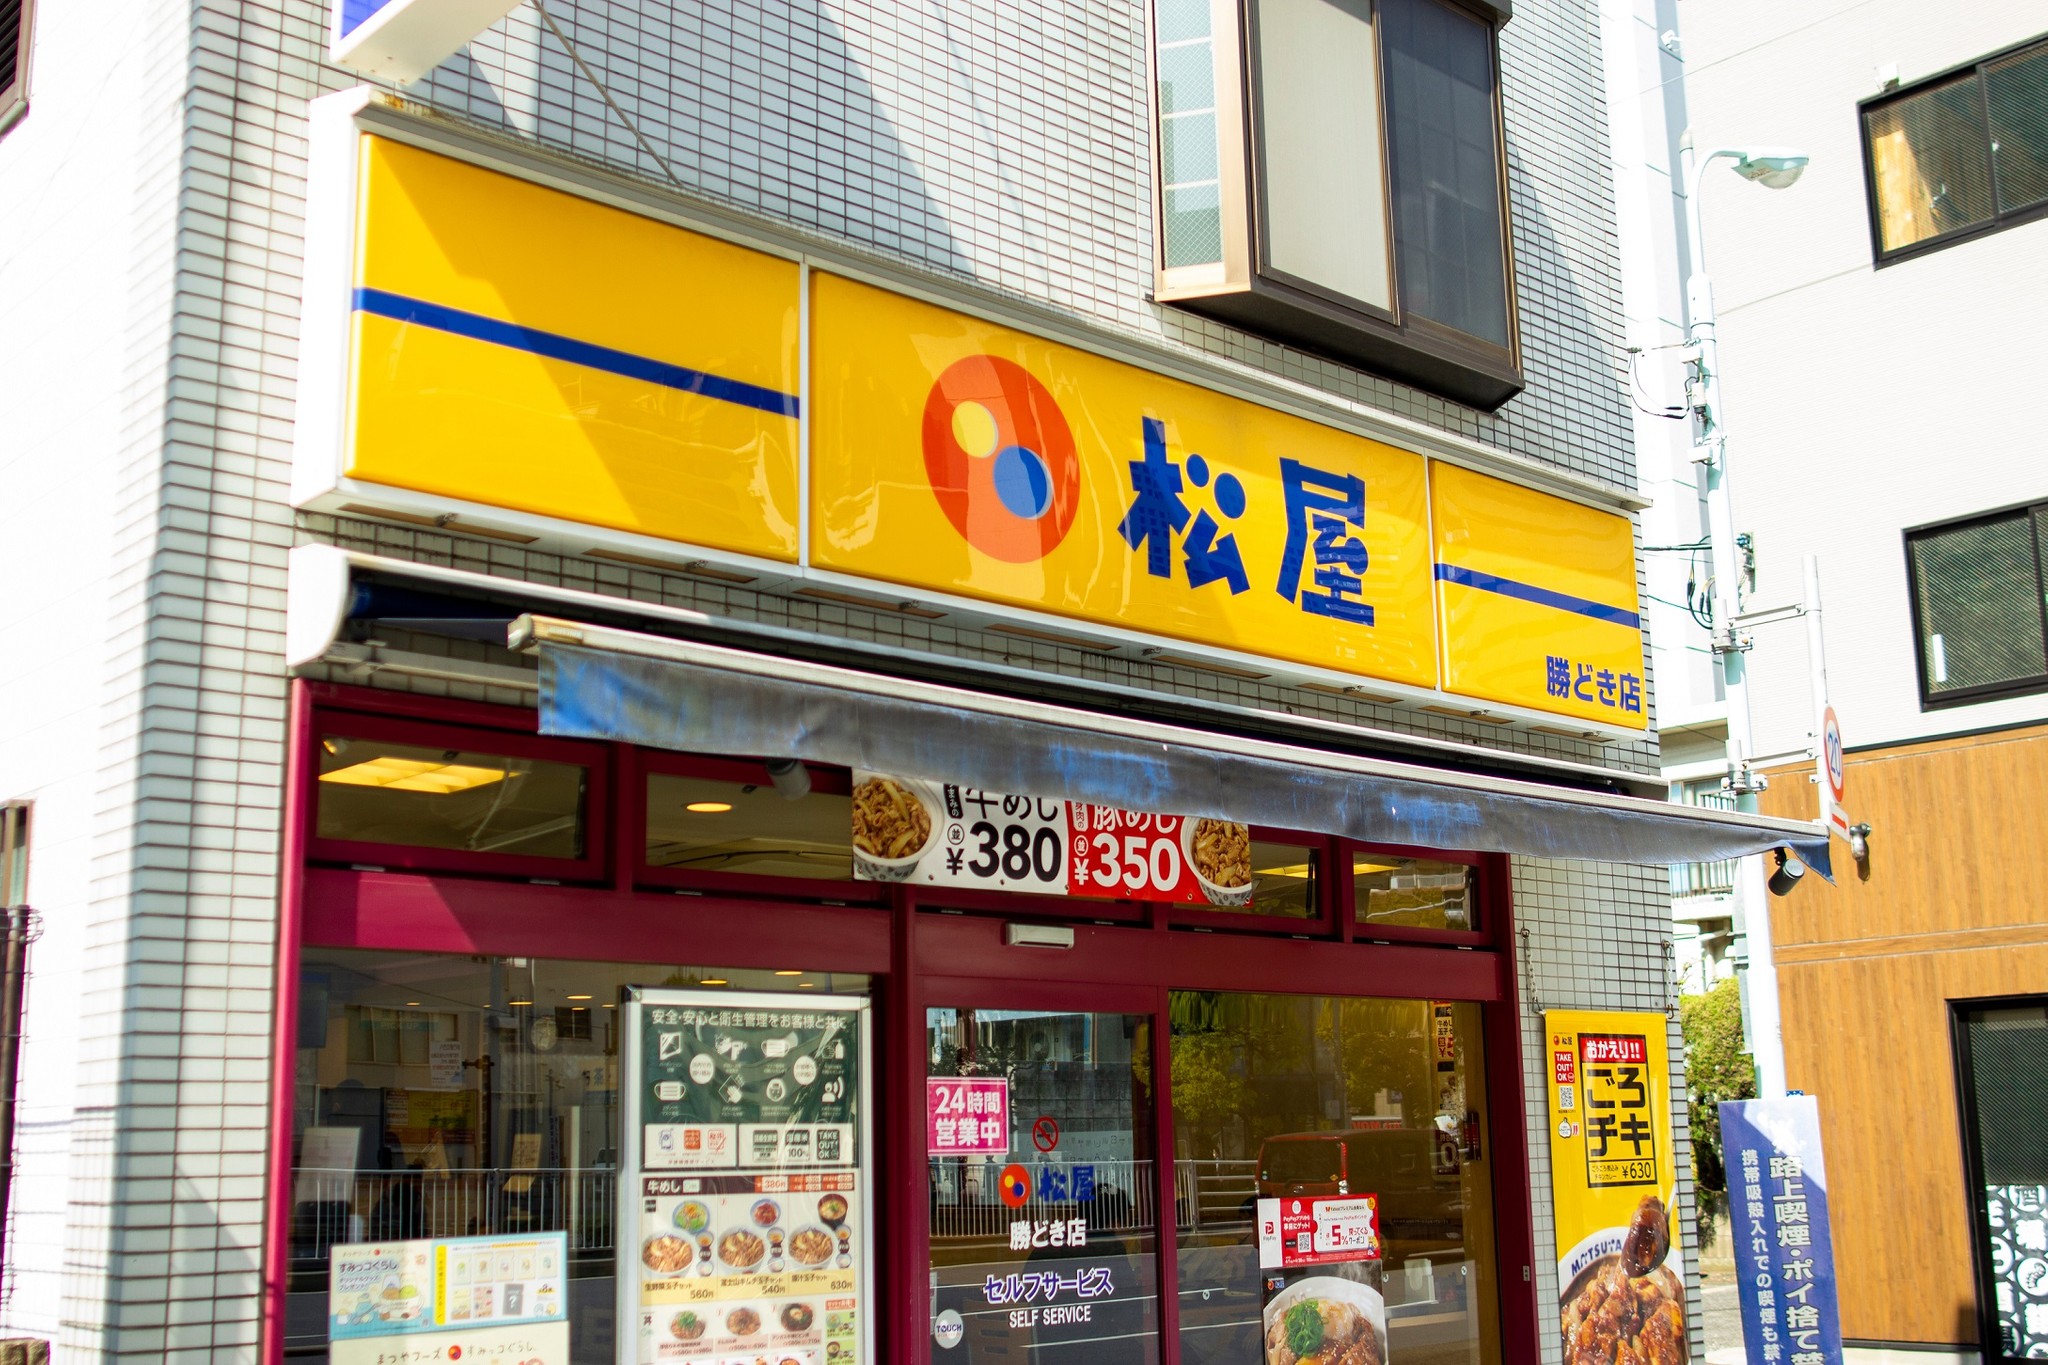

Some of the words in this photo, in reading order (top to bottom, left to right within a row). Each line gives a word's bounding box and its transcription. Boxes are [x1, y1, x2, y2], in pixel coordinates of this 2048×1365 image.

[1117, 416, 1375, 627] 松屋
[1546, 655, 1641, 713] 勝どき店
[1828, 732, 1841, 778] 20
[946, 821, 1062, 882] ¥380
[1074, 833, 1180, 892] ¥350
[1556, 1053, 1572, 1062] TAKE
[1586, 1040, 1641, 1060] おかえり!!
[1557, 1073, 1568, 1082] OK
[935, 1086, 1001, 1115] 24時間
[935, 1117, 1001, 1147] 営業中
[1038, 1165, 1096, 1202] 松屋
[1622, 1162, 1652, 1180] ¥630
[647, 1179, 681, 1194] 牛めし
[1009, 1217, 1087, 1250] 勝どき店
[983, 1267, 1114, 1304] セルフサービス
[936, 1324, 962, 1333] TOUCH
[1009, 1309, 1039, 1328] SELF
[1043, 1305, 1091, 1325] SERVICE
